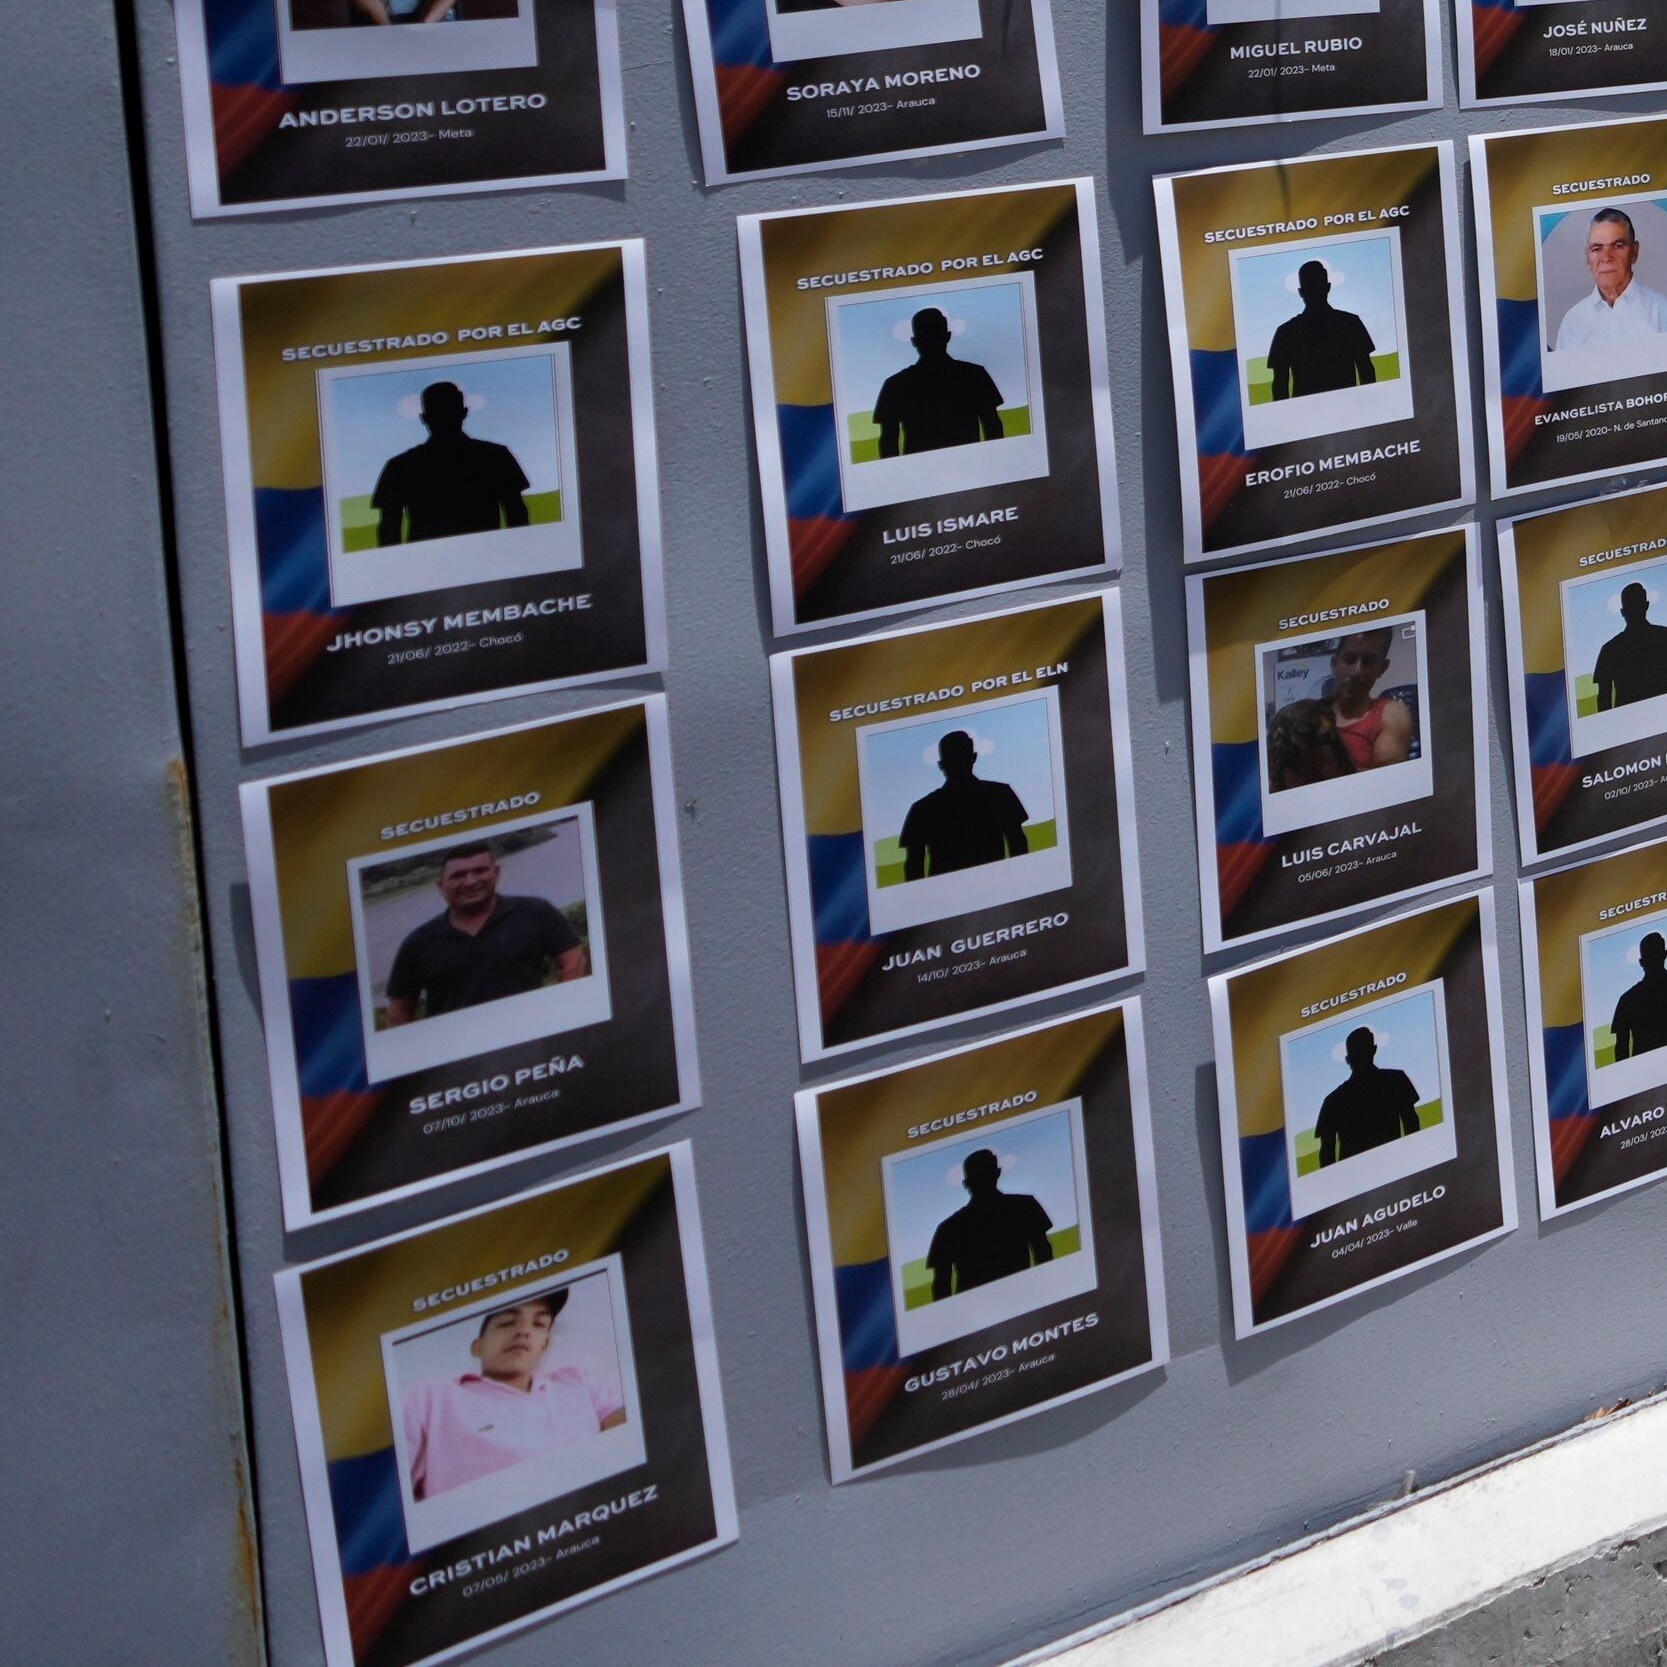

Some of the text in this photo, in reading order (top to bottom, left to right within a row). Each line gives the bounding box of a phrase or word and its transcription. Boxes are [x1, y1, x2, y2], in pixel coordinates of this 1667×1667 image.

[1543, 17, 1647, 38] JOSÉ NUÑEZ
[1230, 37, 1362, 60] MIGUEL RUBIO
[1549, 43, 1633, 57] 18/01/ 2023- Arauca
[786, 64, 980, 101] SORAYA MORENO
[1248, 64, 1335, 78] 22/01/ 2023- Meta
[279, 93, 547, 128] ANDERSON LOTERO
[345, 129, 474, 148] 22/01/ 2023- Meta
[1553, 173, 1650, 195] SECUESTRADO
[1205, 205, 1410, 243] SECUESTRADO POR EL AGC
[797, 248, 1043, 290] SECUESTRADO POR EL AGC
[282, 317, 582, 361] SECUESTRADO POR EL AGC
[1535, 401, 1624, 425] EVANGELISTA
[1245, 440, 1421, 486] EROFIO MEMBACHE
[883, 506, 1019, 544] LUIS ISMARE
[326, 594, 592, 652] JHONSY MEMBACHE
[1279, 598, 1390, 629] SECUESTRADO
[830, 662, 1069, 723] SECUESTRADO POR EL ELN
[1277, 667, 1310, 681] Kalley
[1582, 755, 1661, 788] SALOMON
[381, 791, 541, 840] SECUESTRADO
[1282, 822, 1422, 868] LUIS CARVAJAL
[1297, 851, 1397, 883] 05/06/ 2023- Arauca
[882, 912, 1069, 971] JUAN GUERRERO
[917, 949, 1027, 983] 14/10/ 2023- Arauca
[1301, 972, 1407, 1018] SECUESTRADO
[409, 1055, 584, 1114] SERGIO PEÑA
[907, 1090, 1037, 1138] SECUESTRADO
[1600, 1106, 1664, 1139] ALVARO
[1310, 1185, 1446, 1248] JUAN AGUDELO
[1331, 1219, 1418, 1259] 04/04/ 2023- Valle
[413, 1249, 569, 1311] SECUESTRADO
[904, 1312, 1099, 1392] GUSTAVO MONTES
[409, 1484, 658, 1595] CRISTIAN MARQUEZ
